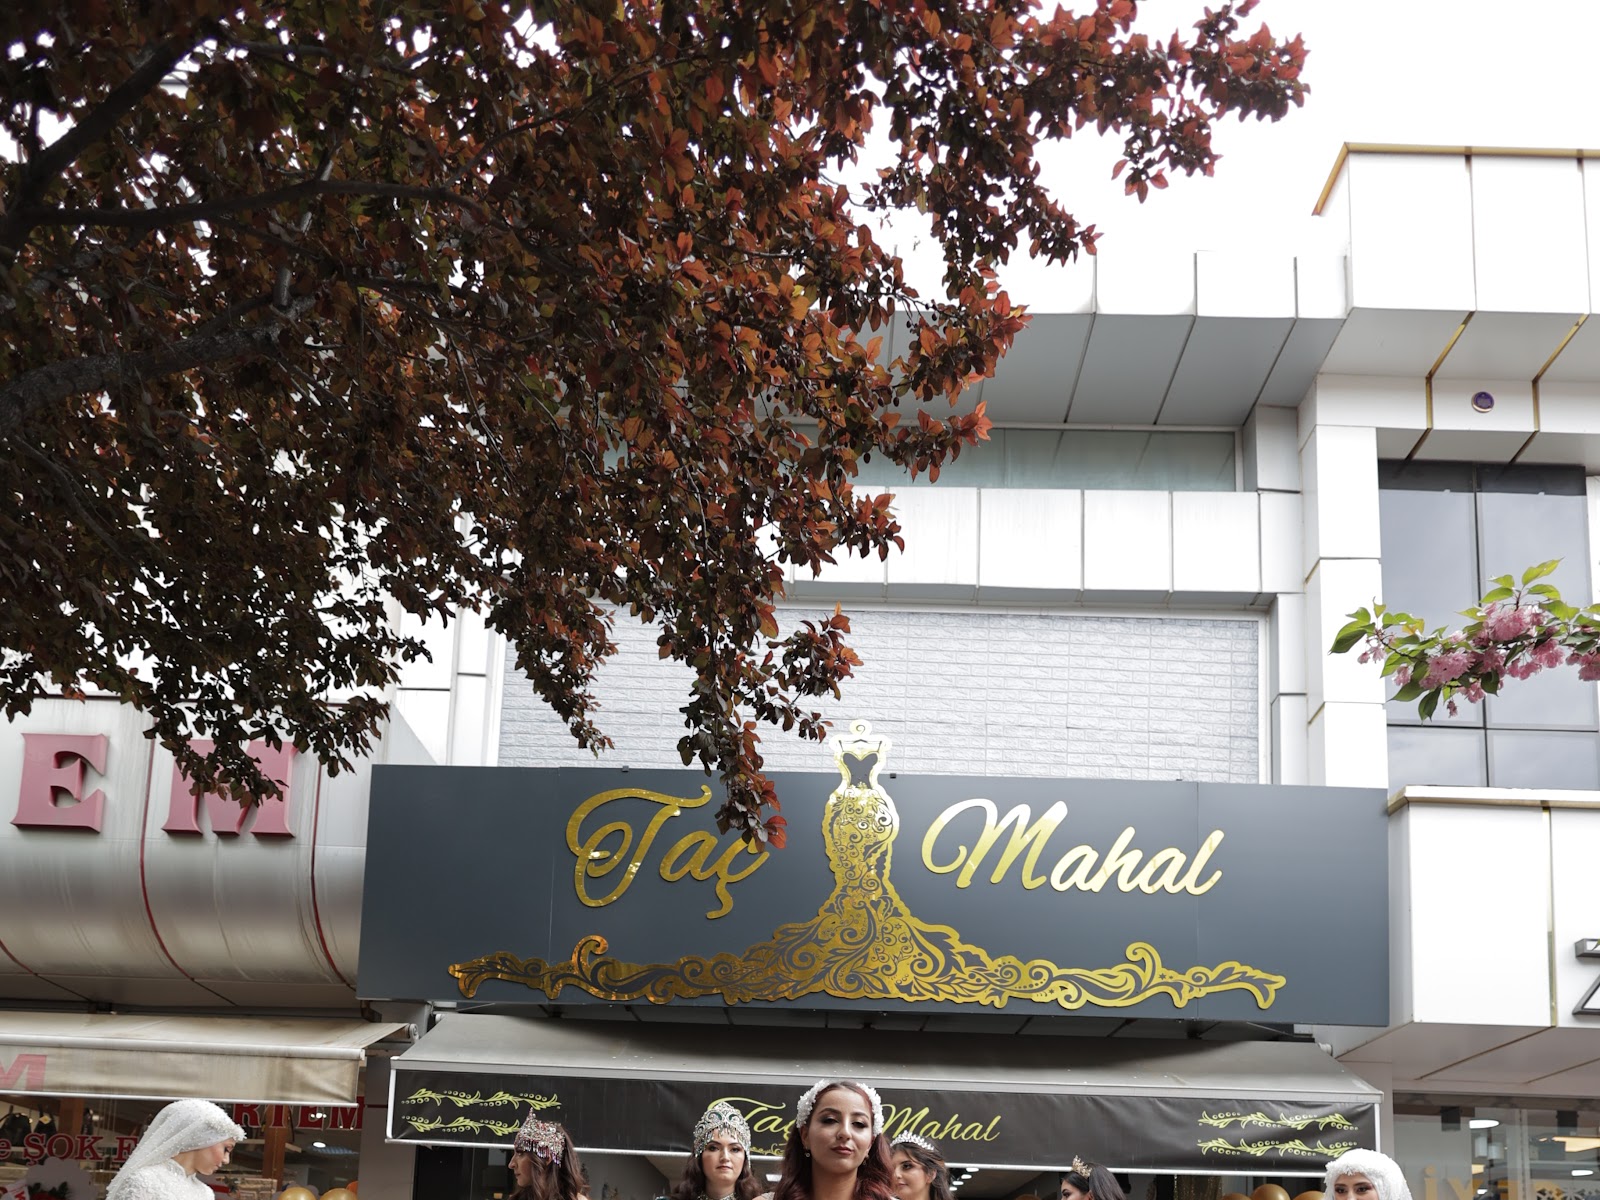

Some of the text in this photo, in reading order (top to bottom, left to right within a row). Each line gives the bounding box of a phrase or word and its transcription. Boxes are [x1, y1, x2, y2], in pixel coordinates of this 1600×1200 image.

[566, 784, 1225, 919] Taç Mahal
[881, 1104, 1001, 1141] Mahal
[23, 1132, 104, 1166] ŞOK
